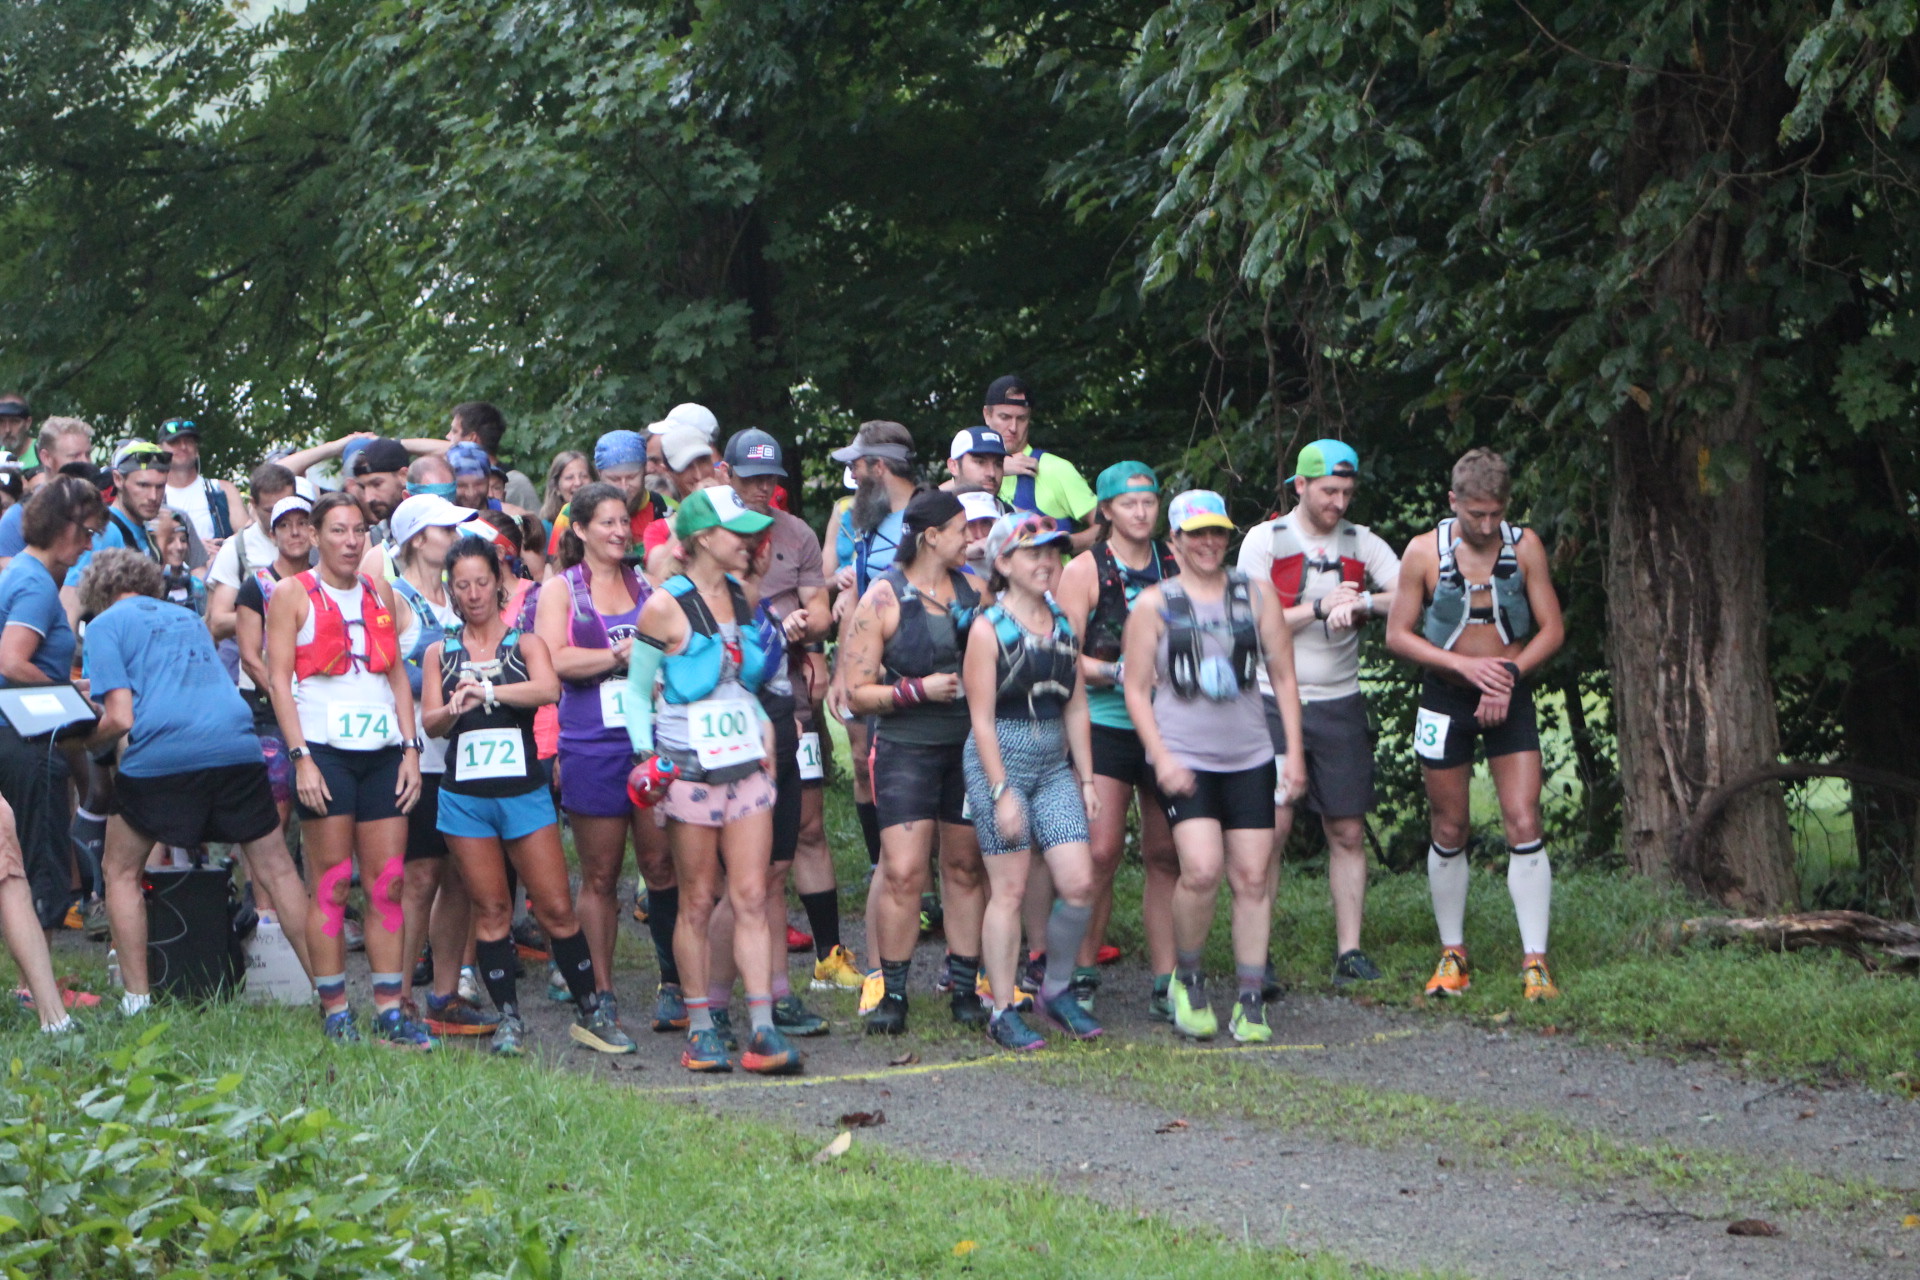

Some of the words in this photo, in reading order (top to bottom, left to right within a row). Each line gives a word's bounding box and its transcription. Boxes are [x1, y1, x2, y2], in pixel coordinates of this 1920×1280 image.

[338, 713, 389, 738] 174
[701, 710, 748, 738] 100
[465, 740, 516, 767] 172
